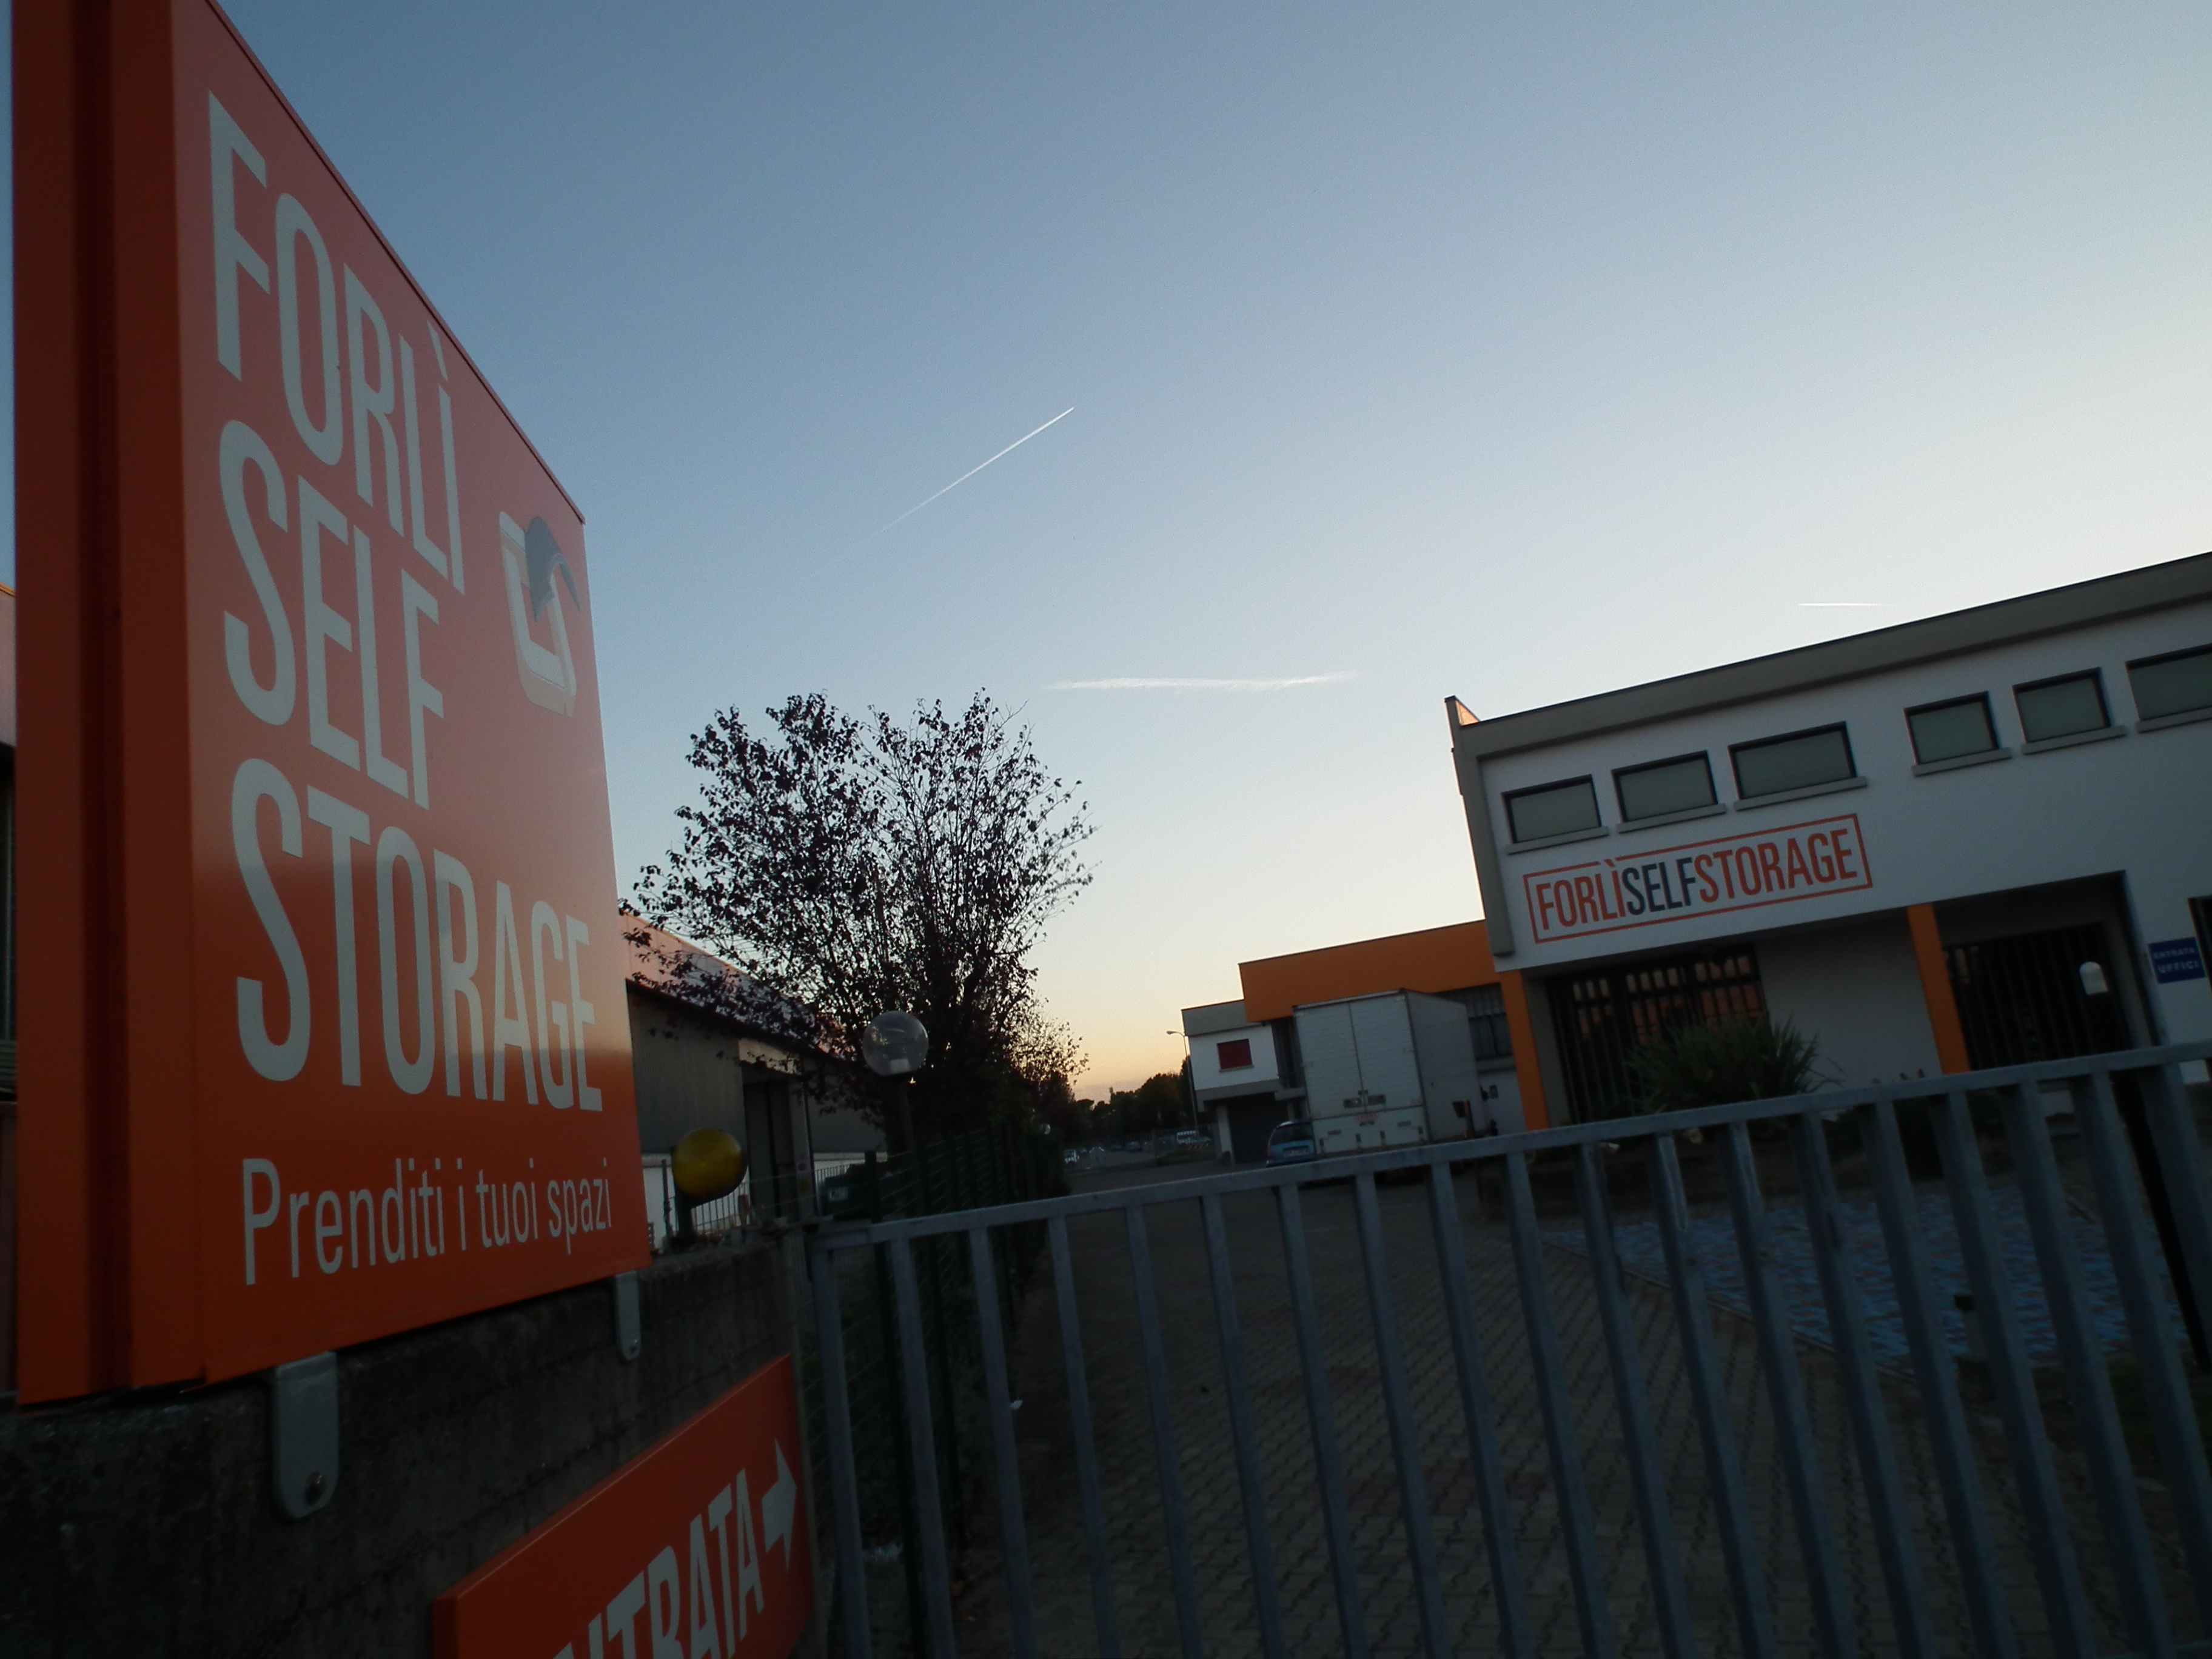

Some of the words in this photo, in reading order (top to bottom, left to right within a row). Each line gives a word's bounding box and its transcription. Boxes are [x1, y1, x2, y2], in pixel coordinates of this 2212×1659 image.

[208, 89, 464, 595] FORLÌ
[219, 420, 444, 810] SELF
[231, 758, 603, 1111] STORAGE
[2157, 960, 2199, 974] UFFICI
[242, 1158, 446, 1285] Prenditi
[457, 1158, 467, 1252] i
[476, 1158, 539, 1249] tuoi
[548, 1158, 612, 1255] spazi
[552, 1468, 765, 1659] TRATA
